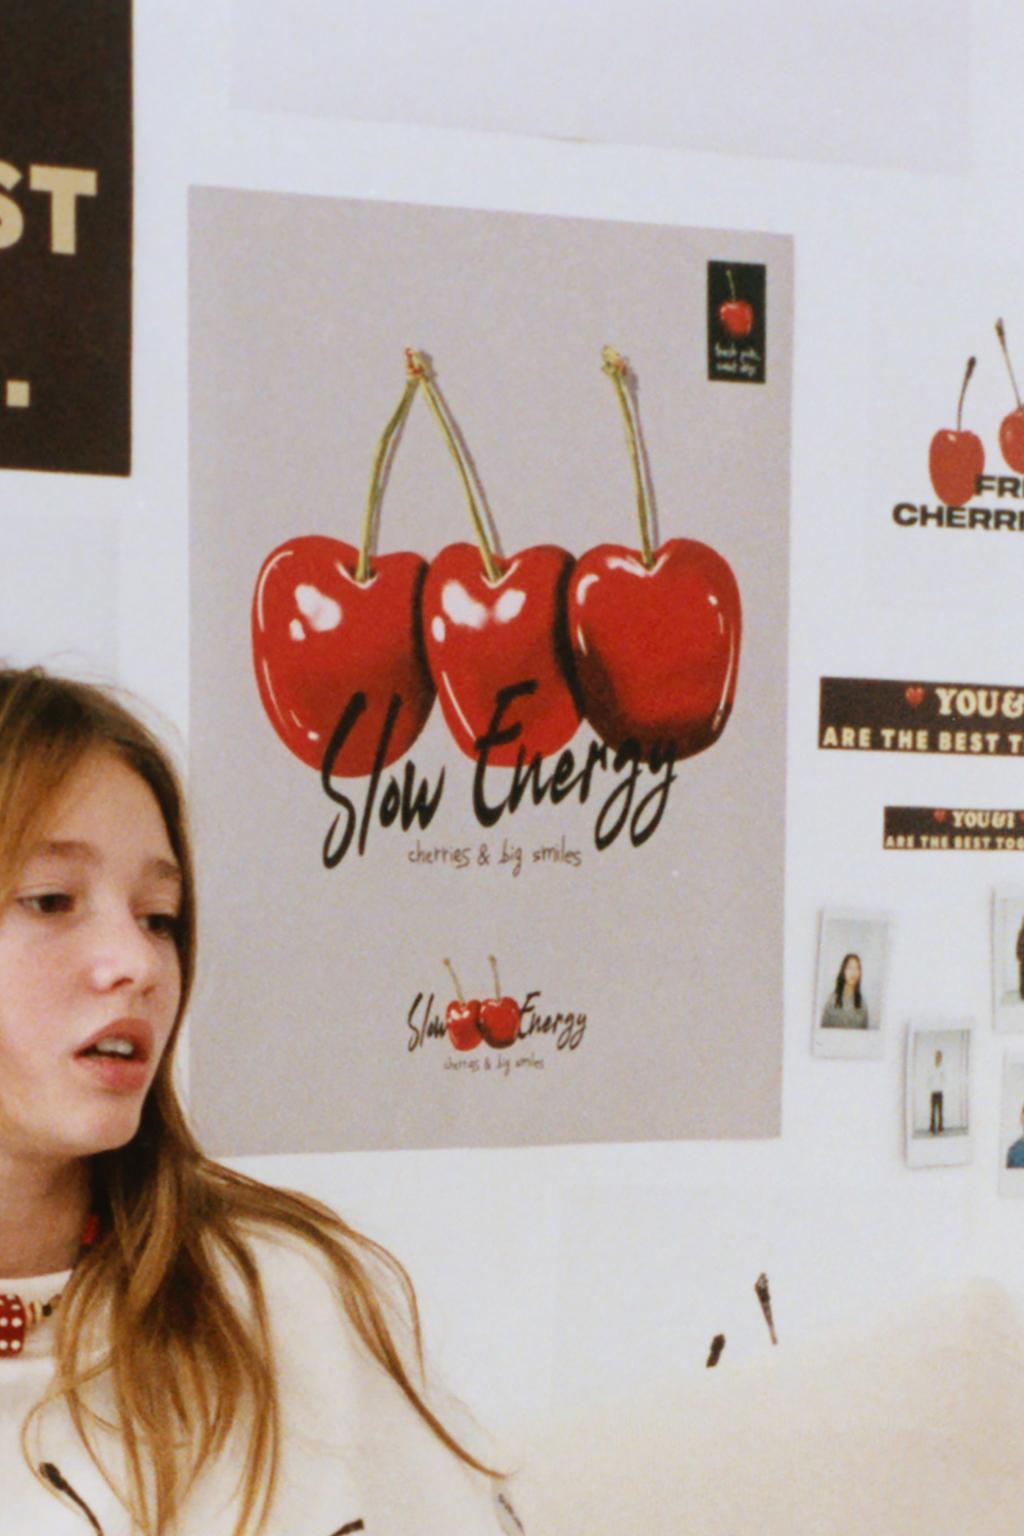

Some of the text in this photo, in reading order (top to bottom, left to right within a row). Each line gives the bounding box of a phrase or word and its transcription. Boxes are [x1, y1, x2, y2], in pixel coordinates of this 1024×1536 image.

[975, 475, 1024, 499] FR
[823, 726, 872, 748] ARE
[881, 728, 929, 750] THE
[938, 730, 1000, 753] BEST
[320, 679, 678, 869] Slow Energy
[408, 834, 582, 877] cherries & big smiles
[885, 834, 915, 850] ARE
[919, 835, 949, 850] THE
[517, 990, 588, 1051] Energy
